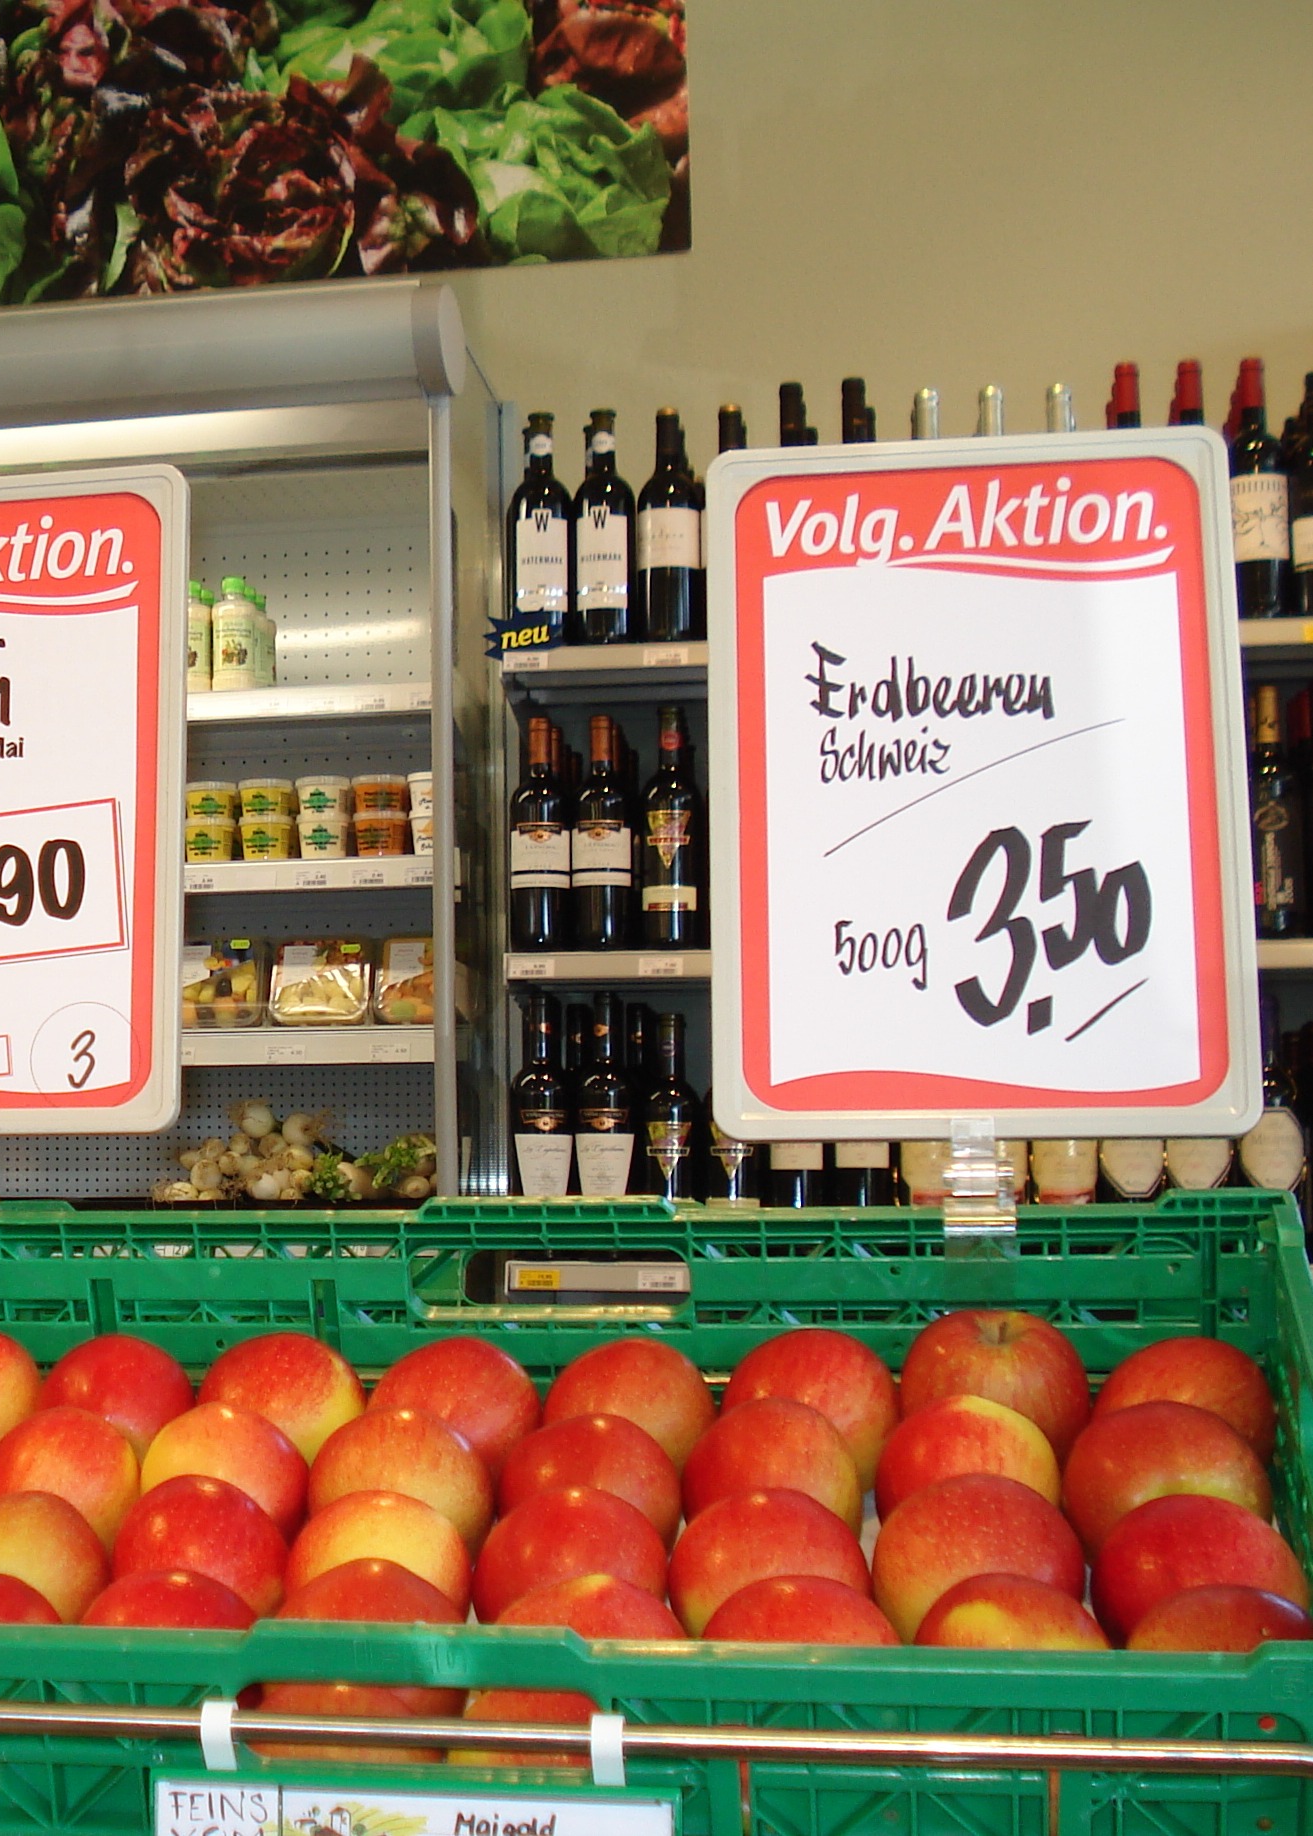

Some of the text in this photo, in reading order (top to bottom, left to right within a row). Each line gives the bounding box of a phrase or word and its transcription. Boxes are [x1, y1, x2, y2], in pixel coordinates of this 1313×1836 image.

[534, 511, 549, 532] W
[593, 509, 607, 529] W
[766, 477, 1168, 565] Volg. Aktion.
[501, 624, 550, 650] neu
[804, 641, 1054, 719] Erdbeeren
[820, 726, 950, 783] Schweiz
[835, 920, 928, 990] 500g
[947, 820, 1152, 1036] 3.50
[68, 1029, 96, 1089] 3
[169, 1790, 267, 1824] FEINS
[454, 1810, 556, 1836] Maigold
